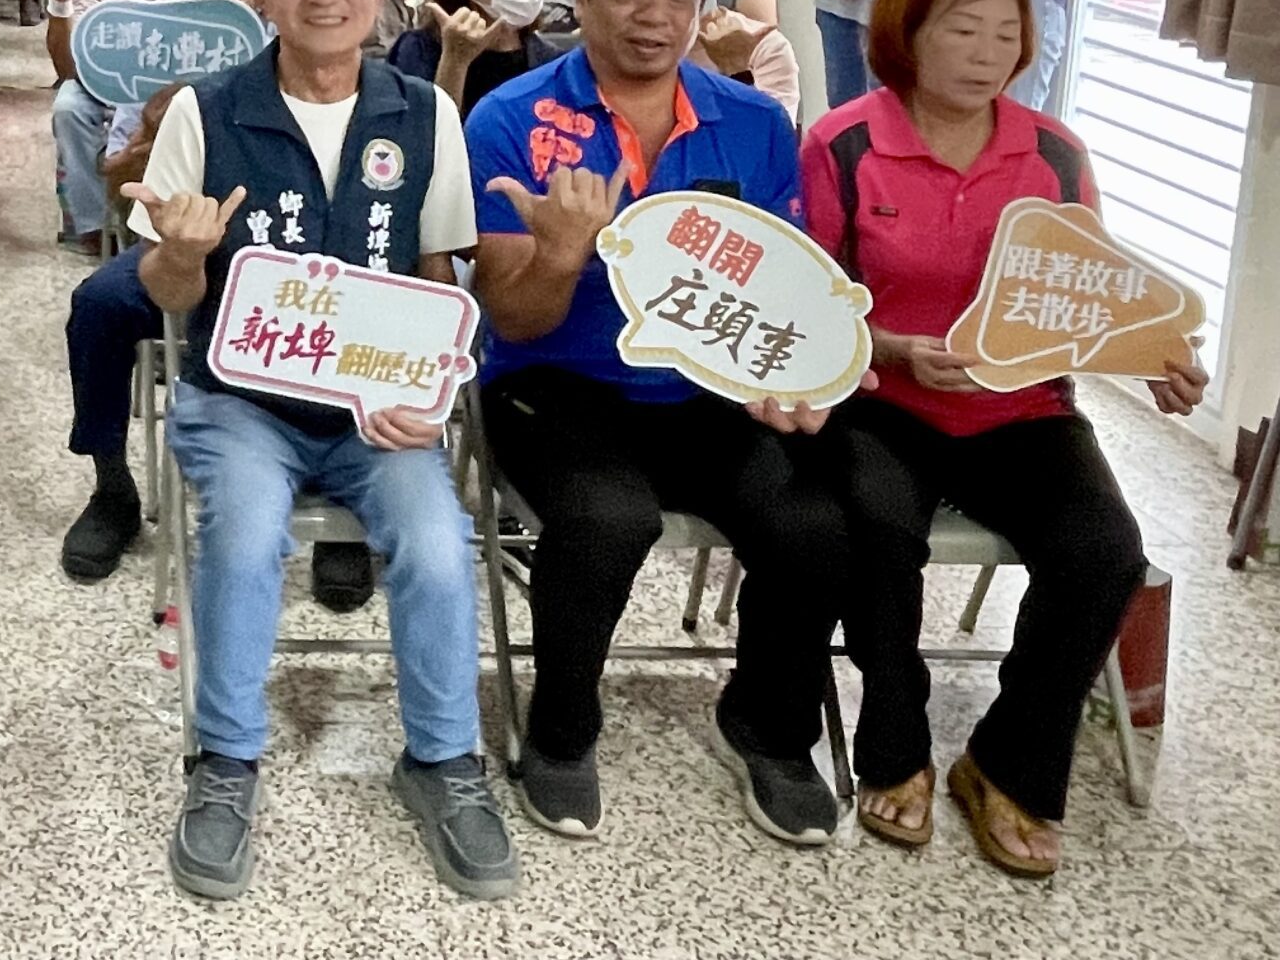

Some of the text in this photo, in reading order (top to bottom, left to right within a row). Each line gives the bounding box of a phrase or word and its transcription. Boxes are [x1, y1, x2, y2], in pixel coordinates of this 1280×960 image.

[666, 205, 765, 288] 翻開
[1003, 243, 1148, 303] 跟著故事
[273, 278, 344, 316] 我在
[644, 268, 807, 381] 庄頭事
[1000, 286, 1115, 339] 去散步
